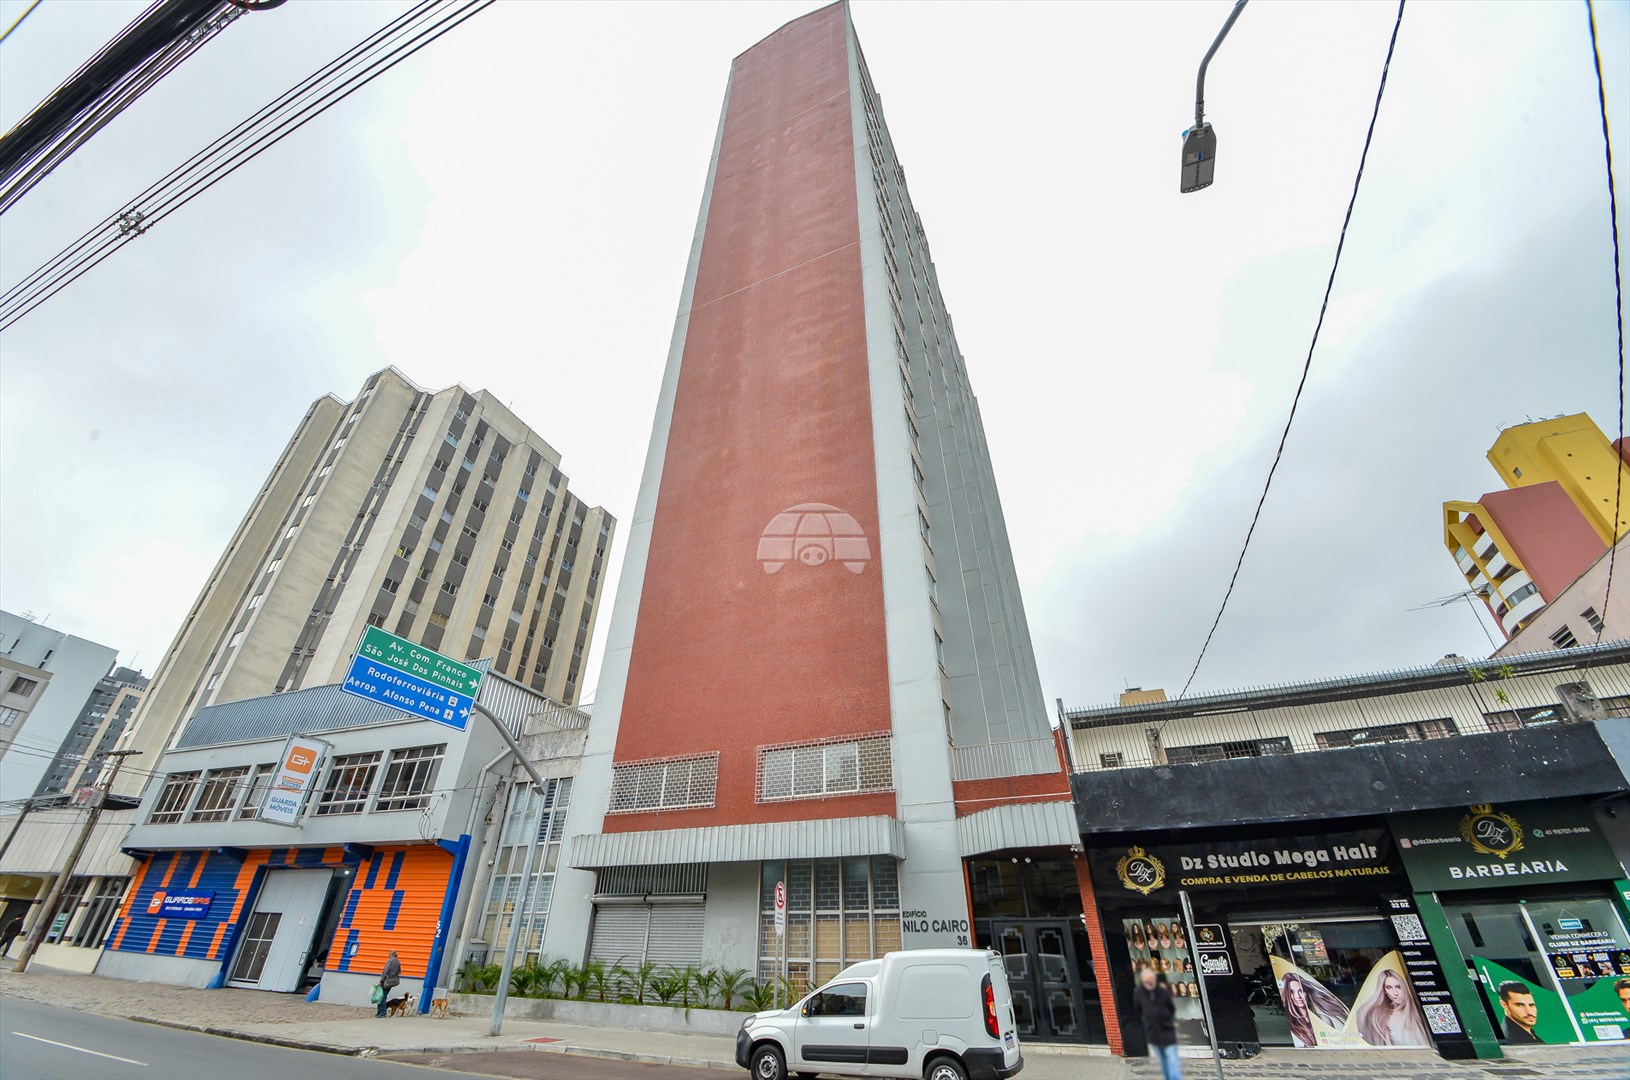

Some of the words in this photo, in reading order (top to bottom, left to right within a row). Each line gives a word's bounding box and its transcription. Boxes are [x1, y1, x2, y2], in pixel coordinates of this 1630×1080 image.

[364, 644, 382, 658] São
[387, 654, 408, 668] José
[412, 662, 428, 675] Dos
[432, 670, 464, 689] Pinhais
[389, 642, 404, 654] Av.
[410, 650, 432, 664] Com.
[436, 660, 467, 678] Franco
[367, 667, 445, 702] Rodoferroviária
[347, 676, 378, 694] Aerop.
[382, 689, 414, 706] Afonso
[418, 701, 440, 715] Pena
[268, 804, 294, 814] MÓVEIS
[271, 796, 297, 807] GUARDA
[1180, 856, 1204, 870] Dz
[1206, 850, 1270, 868] Studio
[1274, 850, 1330, 868] Mega
[1332, 843, 1377, 860] Hair
[1181, 876, 1223, 886] COMPRA
[1232, 874, 1269, 883] VENDA
[1286, 870, 1334, 880] CABELOS
[1335, 866, 1390, 877] NATURAIS
[1449, 860, 1568, 879] BARBEARIA
[902, 909, 927, 918] EDIFÍCIO
[435, 921, 441, 938] 52
[903, 920, 928, 932] NILO
[932, 920, 968, 932] CAIRO
[957, 936, 968, 946] 36
